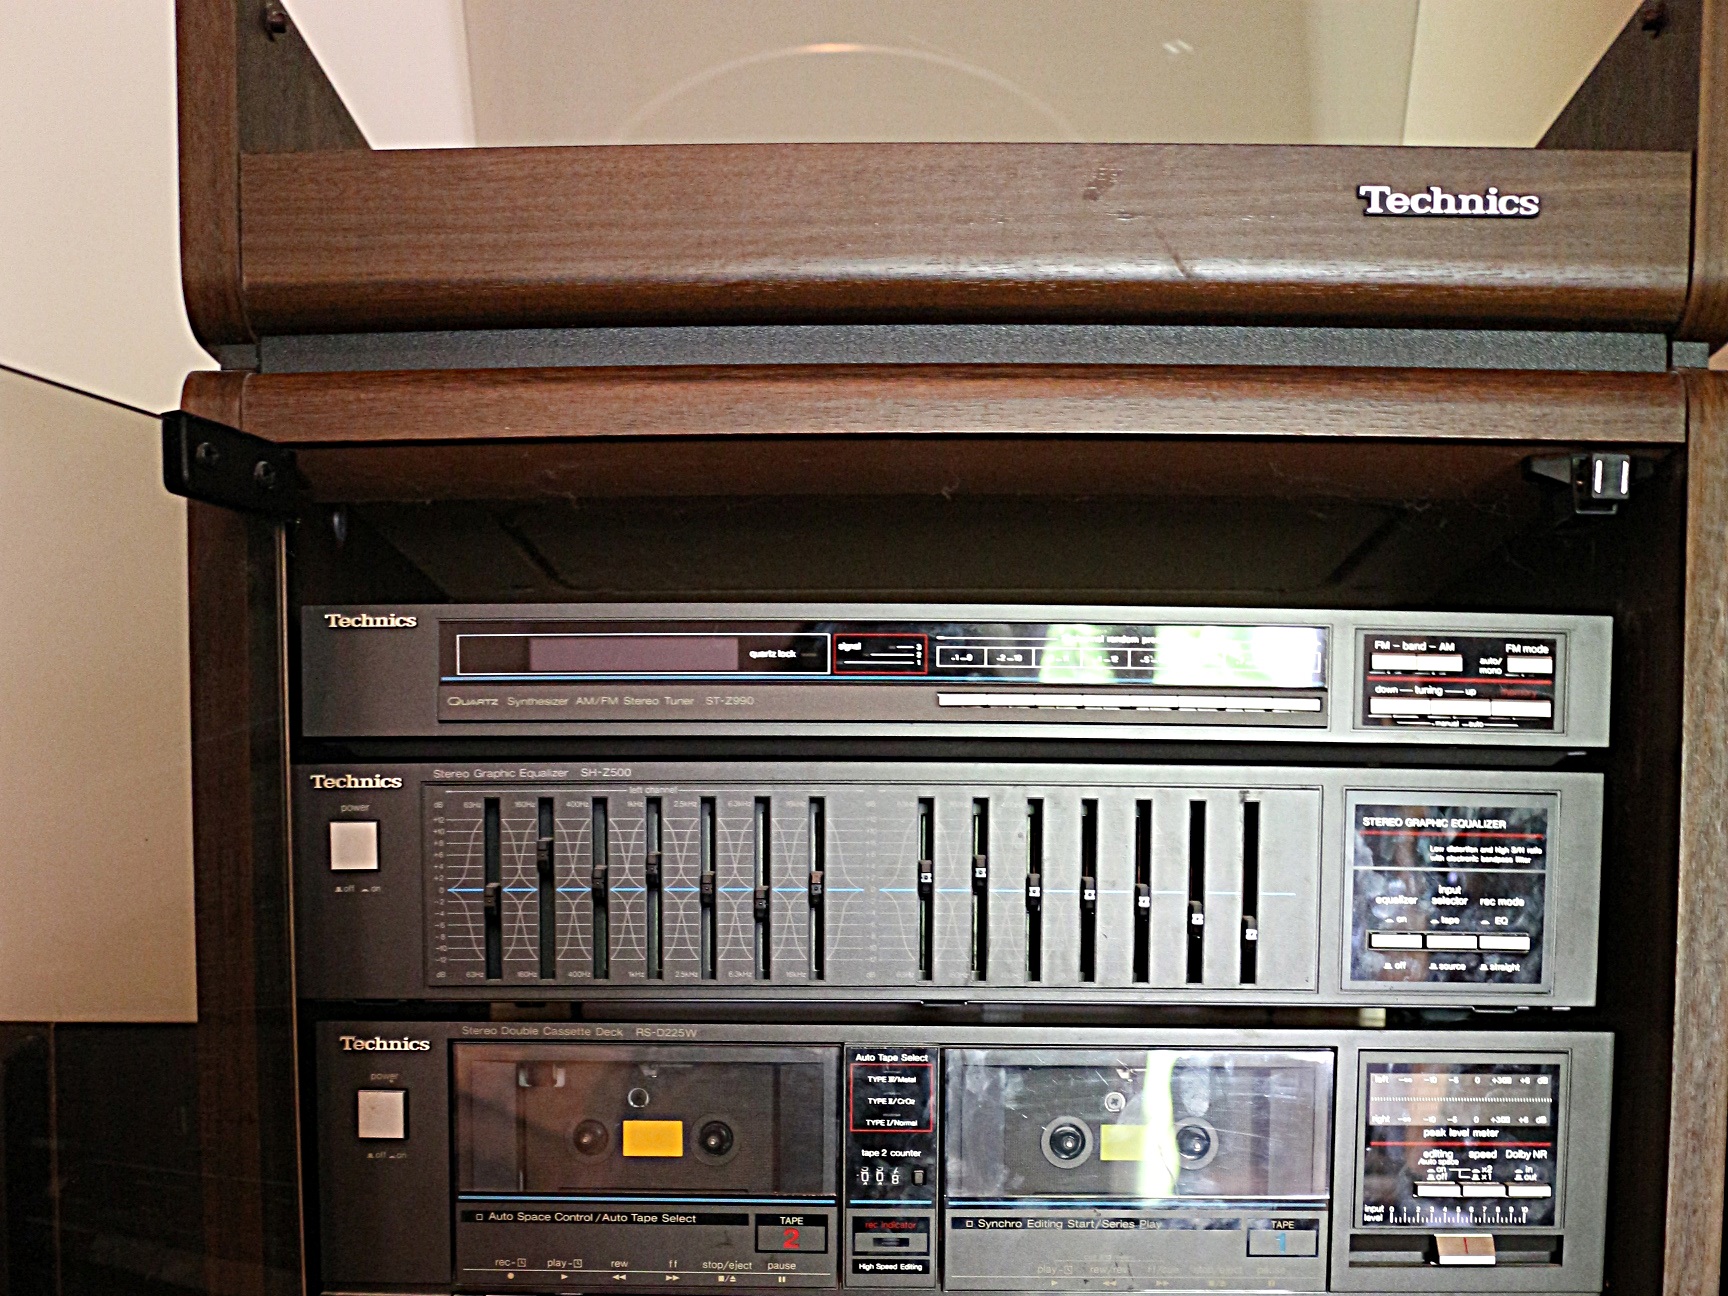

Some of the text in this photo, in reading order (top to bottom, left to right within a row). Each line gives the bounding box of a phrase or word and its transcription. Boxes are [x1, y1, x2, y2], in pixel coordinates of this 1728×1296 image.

[1359, 185, 1540, 215] Technics
[325, 614, 417, 628] Technics
[1375, 641, 1455, 651] FM band AM
[1506, 644, 1549, 654] FM mode
[1375, 686, 1398, 694] down
[1415, 686, 1443, 696] tuning
[507, 697, 569, 707] Synthesizer
[575, 697, 619, 705] AM/FM
[624, 697, 659, 705] Stereo
[664, 697, 694, 705] Tuner
[706, 697, 754, 705] ST-Z990
[433, 768, 631, 780] Stereo Graphic Equalizer SH-Z500
[310, 775, 402, 789] Technics
[341, 804, 369, 812] power
[1363, 817, 1506, 829] STEREO GRAPHIC EQUALIZER
[1439, 885, 1461, 895] input
[1376, 896, 1524, 907] equalizer selector rec mode
[462, 1026, 698, 1037] Stereo Double Cassette Deck RS-D225W
[340, 1036, 430, 1050] Technics
[878, 1054, 898, 1063] Tape
[901, 1054, 928, 1062] Select
[371, 1072, 399, 1081] power
[1424, 1128, 1499, 1138] peak level meter
[862, 1150, 880, 1158] tape
[1423, 1150, 1453, 1159] editing
[1469, 1150, 1497, 1159] speed
[1506, 1150, 1547, 1160] Dolby NR
[488, 1212, 513, 1222] Auto
[517, 1213, 551, 1223] Space
[555, 1213, 593, 1223] Control
[631, 1214, 658, 1224] Tape
[662, 1214, 696, 1224] Select
[780, 1217, 803, 1225] TAPE
[881, 1221, 916, 1229] indicator
[978, 1219, 1161, 1230] Synchro Editing Start/Series Play
[1272, 1221, 1294, 1229] TAPE
[783, 1228, 800, 1249] 2
[1275, 1233, 1286, 1252] 1
[611, 1260, 628, 1268] rew
[702, 1261, 752, 1271] stop/eject
[768, 1262, 796, 1271] pause
[876, 1263, 897, 1271] Speed
[900, 1263, 922, 1271] Editing
